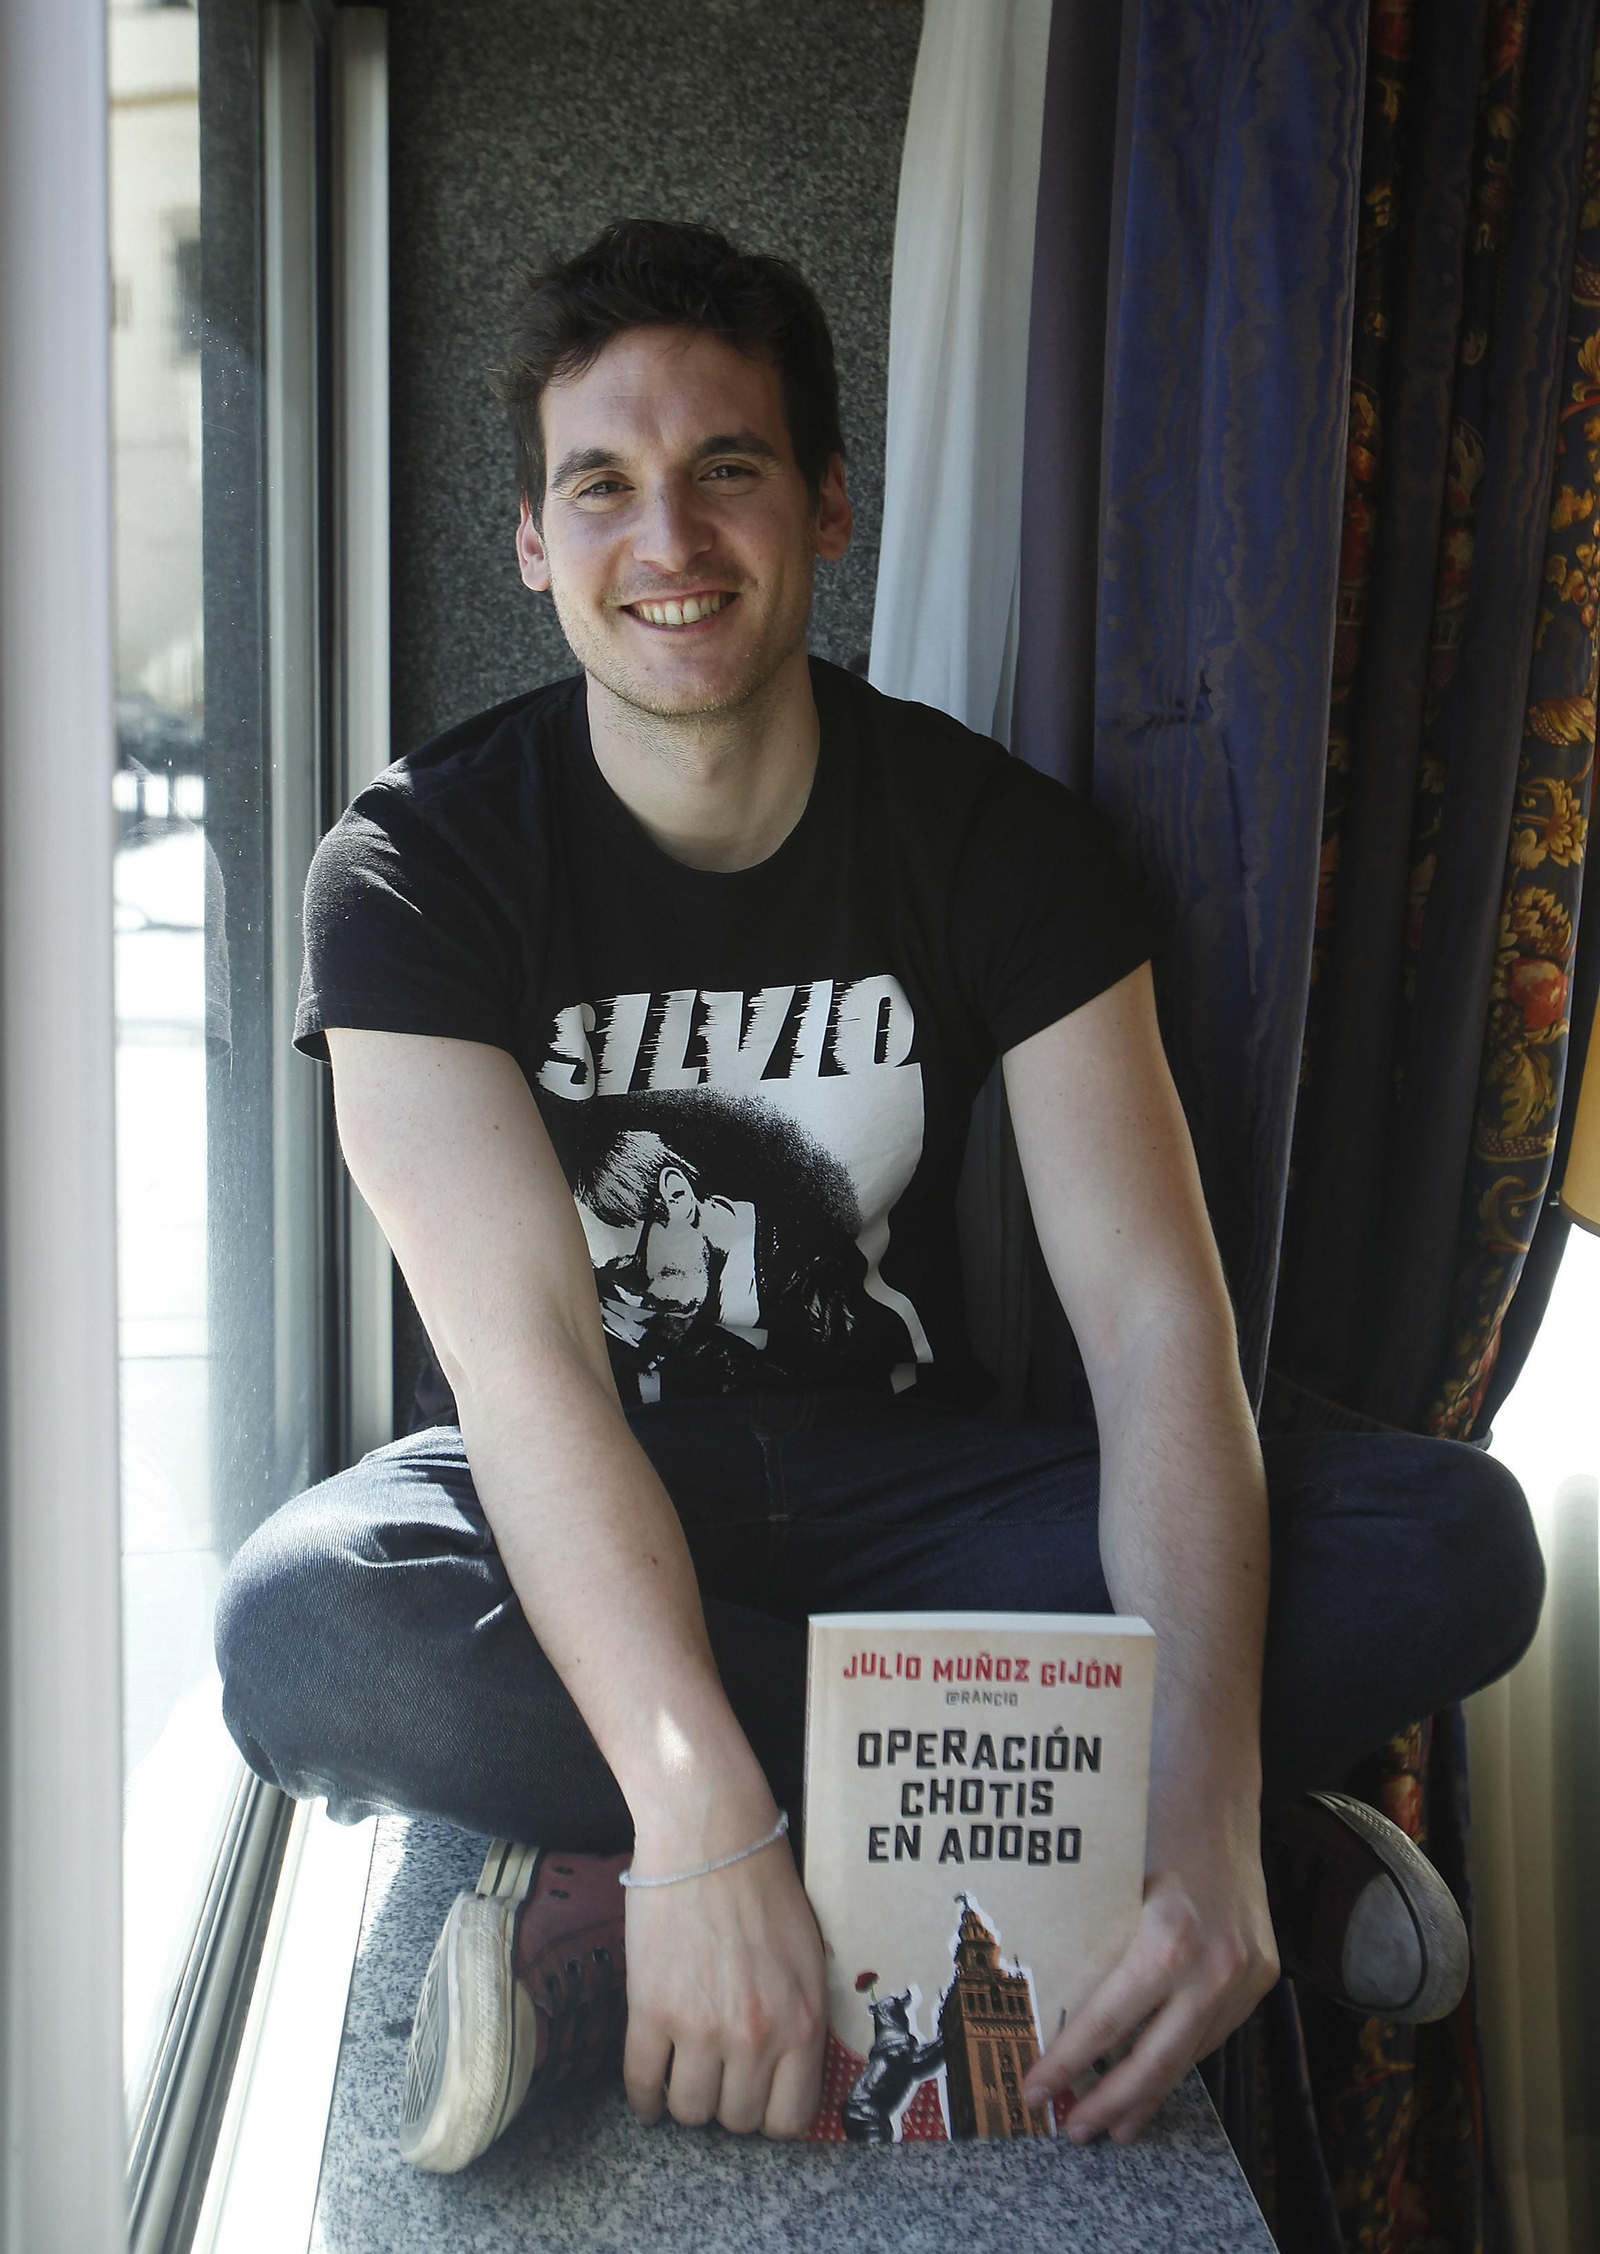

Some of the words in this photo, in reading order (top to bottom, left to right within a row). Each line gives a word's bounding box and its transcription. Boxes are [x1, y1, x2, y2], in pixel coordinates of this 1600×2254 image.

[535, 974, 920, 1101] SILVIO
[843, 1651, 921, 1680] JULIO
[933, 1652, 1030, 1683] MUÑOZ
[1040, 1659, 1123, 1688] GIJÓN
[945, 1691, 1018, 1707] @RANCIO
[857, 1725, 1102, 1773] OPERACIÓN
[901, 1778, 1054, 1819] CHOTIS
[868, 1825, 921, 1863] EN
[938, 1825, 1082, 1866] ADOBO
